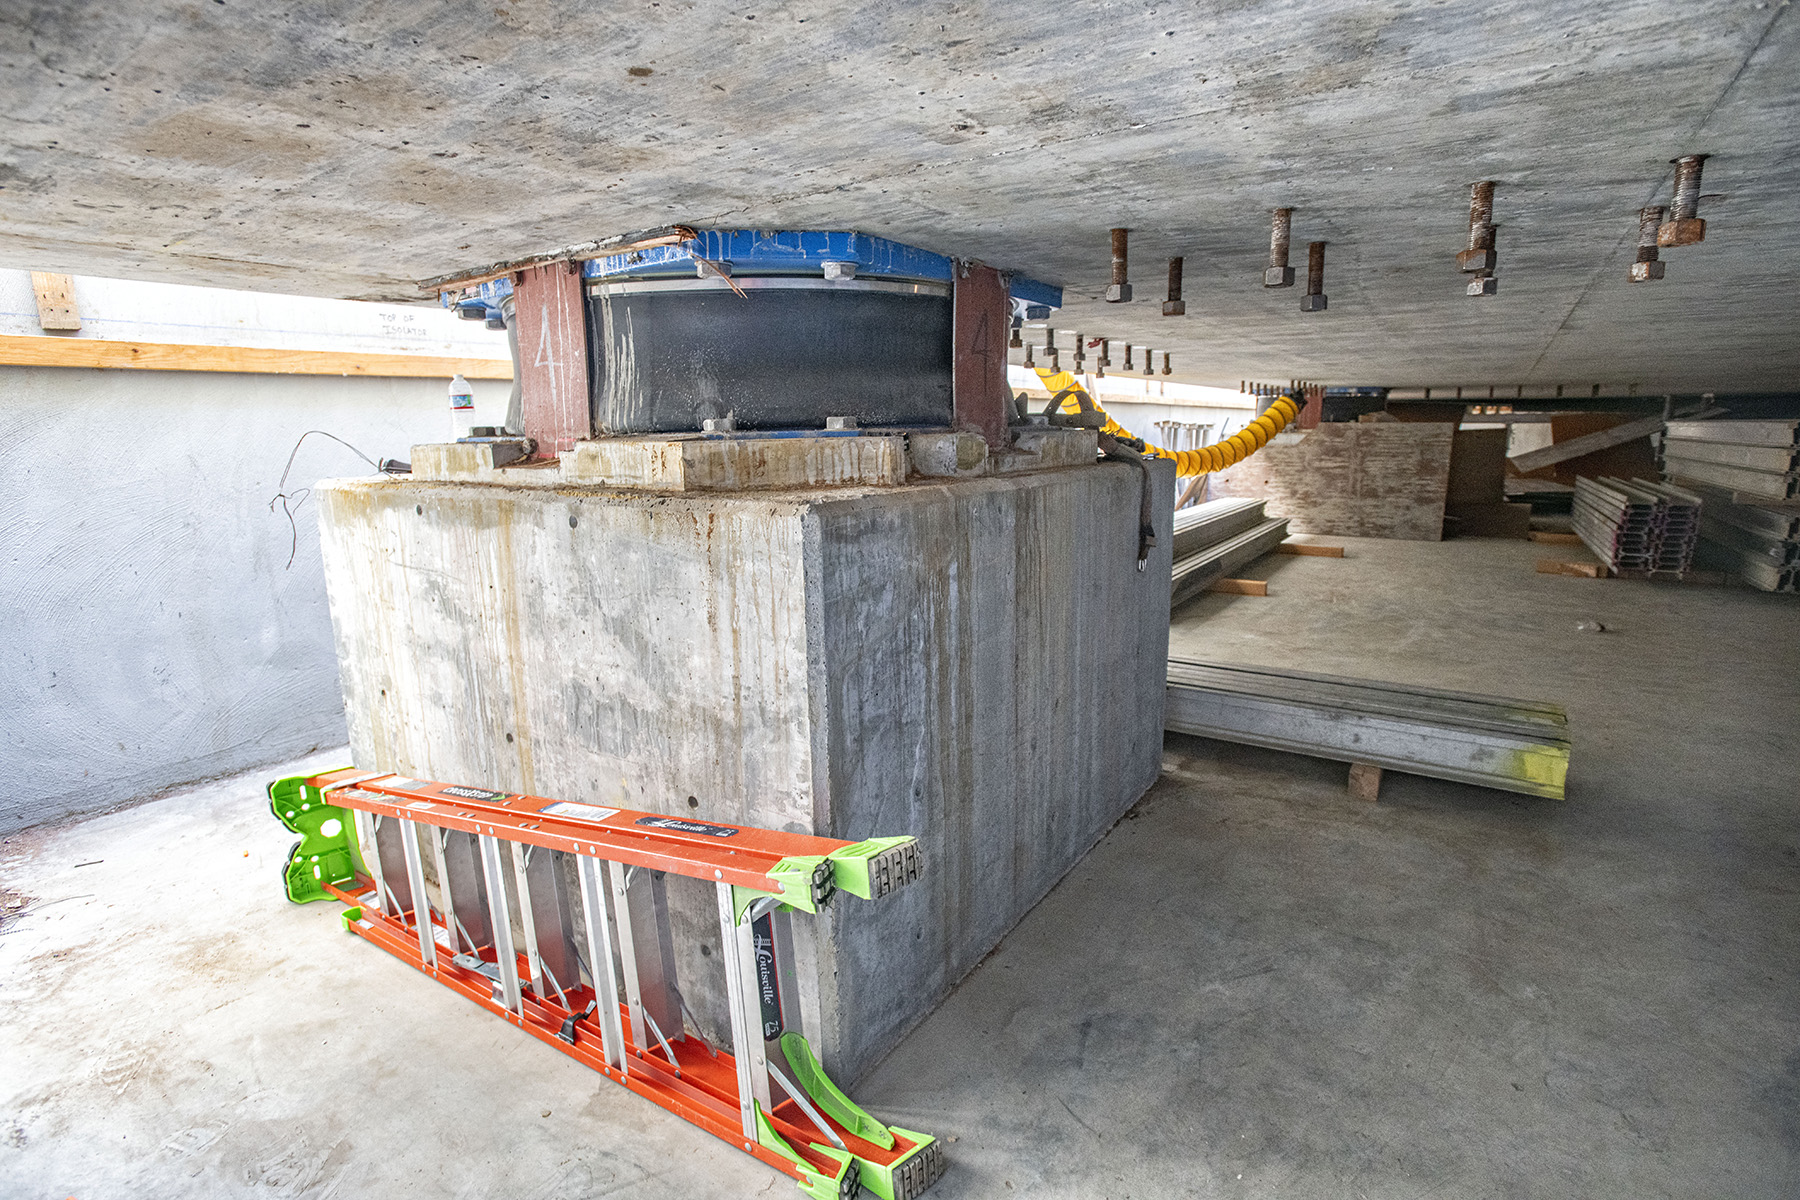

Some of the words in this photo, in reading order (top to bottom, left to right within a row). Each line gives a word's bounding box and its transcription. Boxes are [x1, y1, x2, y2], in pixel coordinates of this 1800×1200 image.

[379, 313, 396, 322] TOP
[403, 314, 415, 322] OF
[382, 325, 427, 336] ISOLATOR
[971, 309, 989, 397] 4
[534, 304, 564, 404] 4
[753, 933, 774, 1005] Louisville
